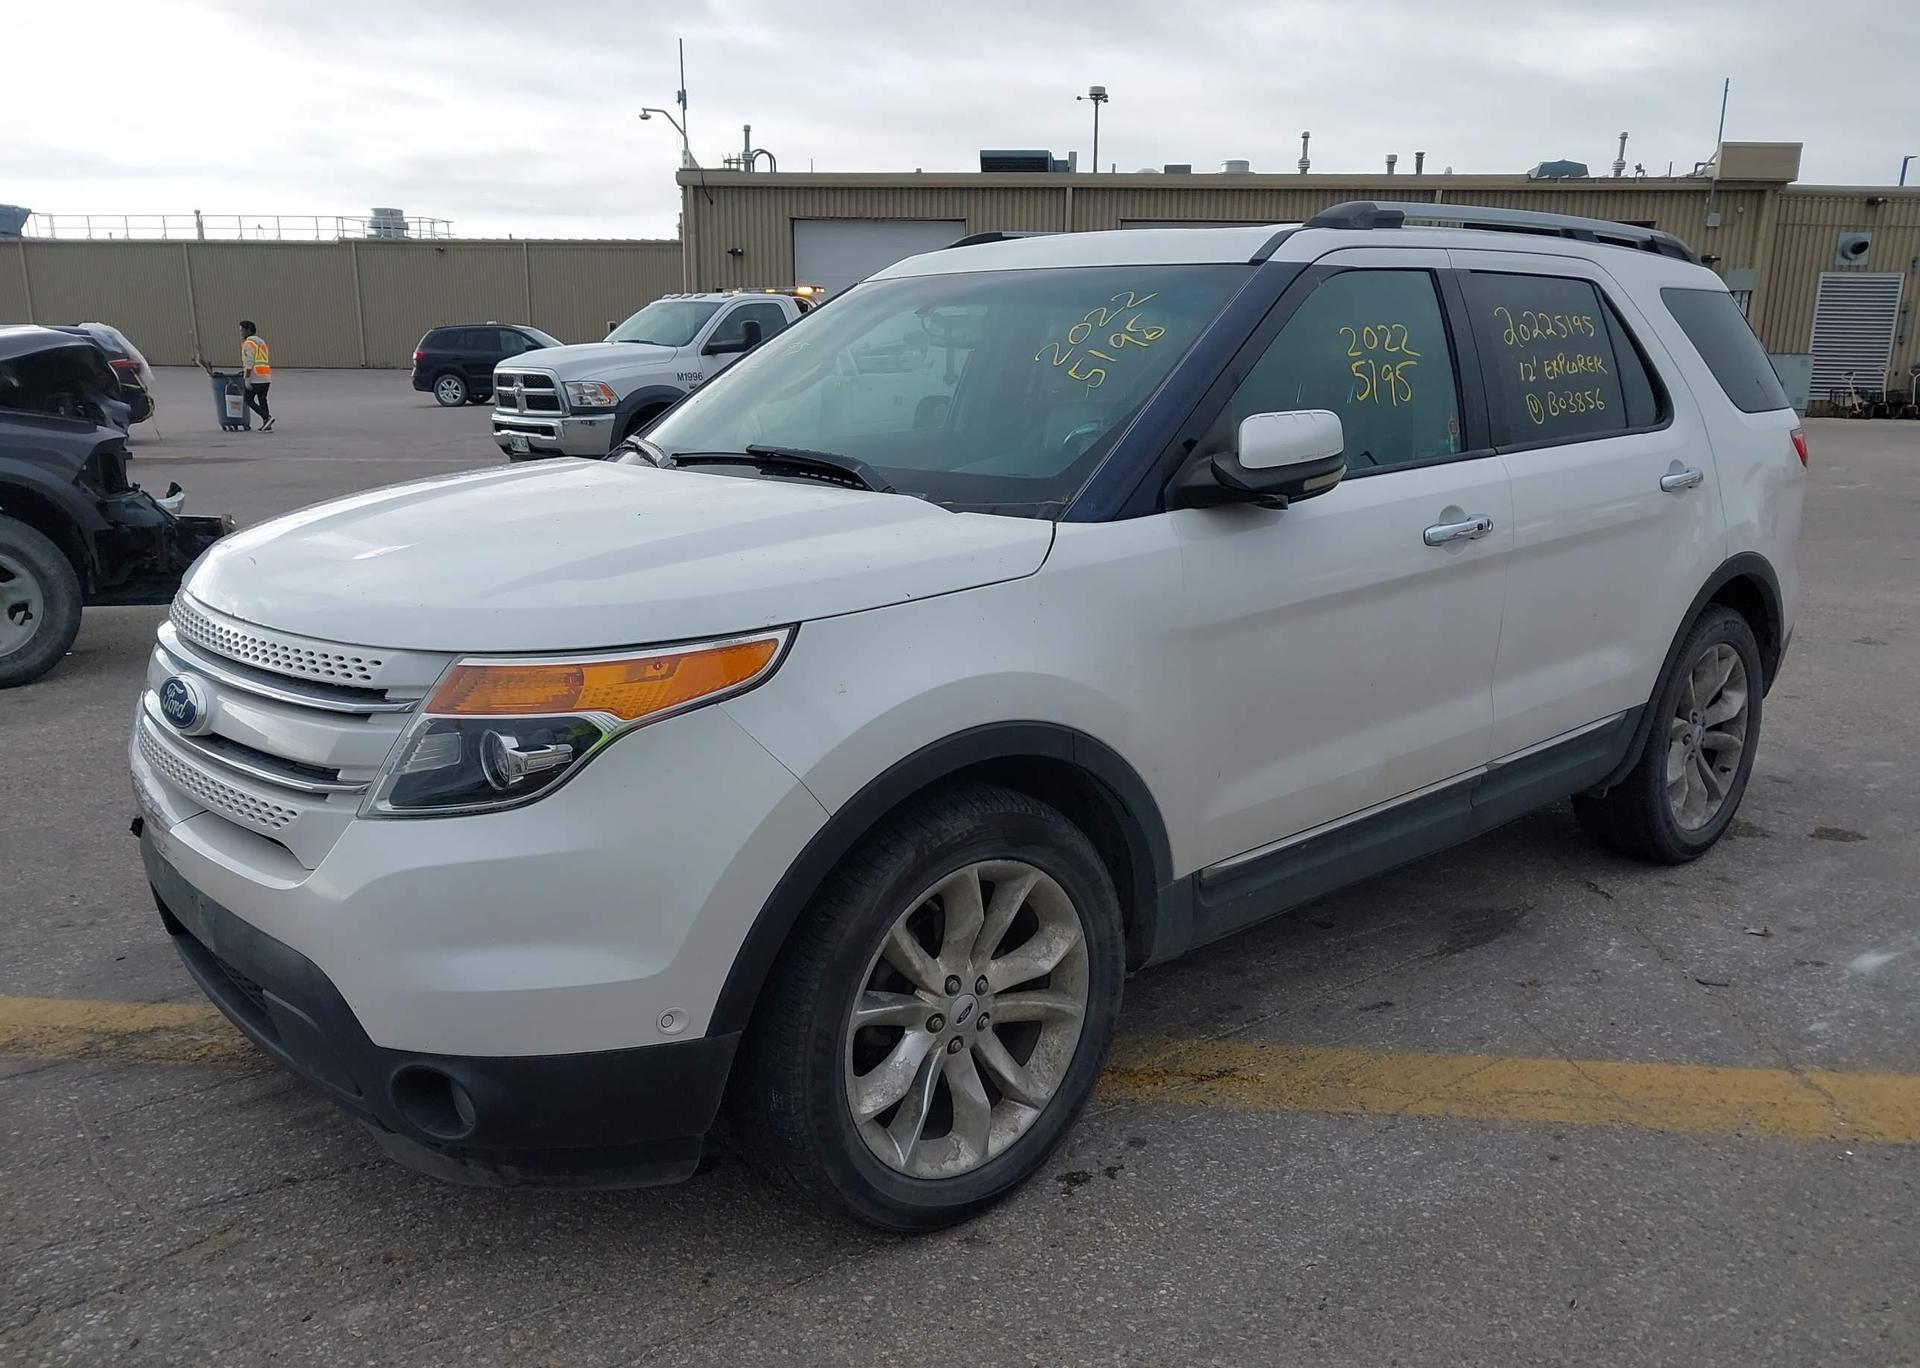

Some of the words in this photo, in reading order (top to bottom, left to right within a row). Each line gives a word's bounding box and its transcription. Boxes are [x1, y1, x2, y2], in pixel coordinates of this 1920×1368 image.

[1034, 291, 1160, 366] 2022
[1339, 323, 1421, 357] 2022
[1494, 306, 1595, 347] 20225195
[676, 371, 704, 382] M1996
[1351, 360, 1418, 407] 5195
[1544, 352, 1609, 380] EXPLORER
[162, 682, 189, 719] Ford
